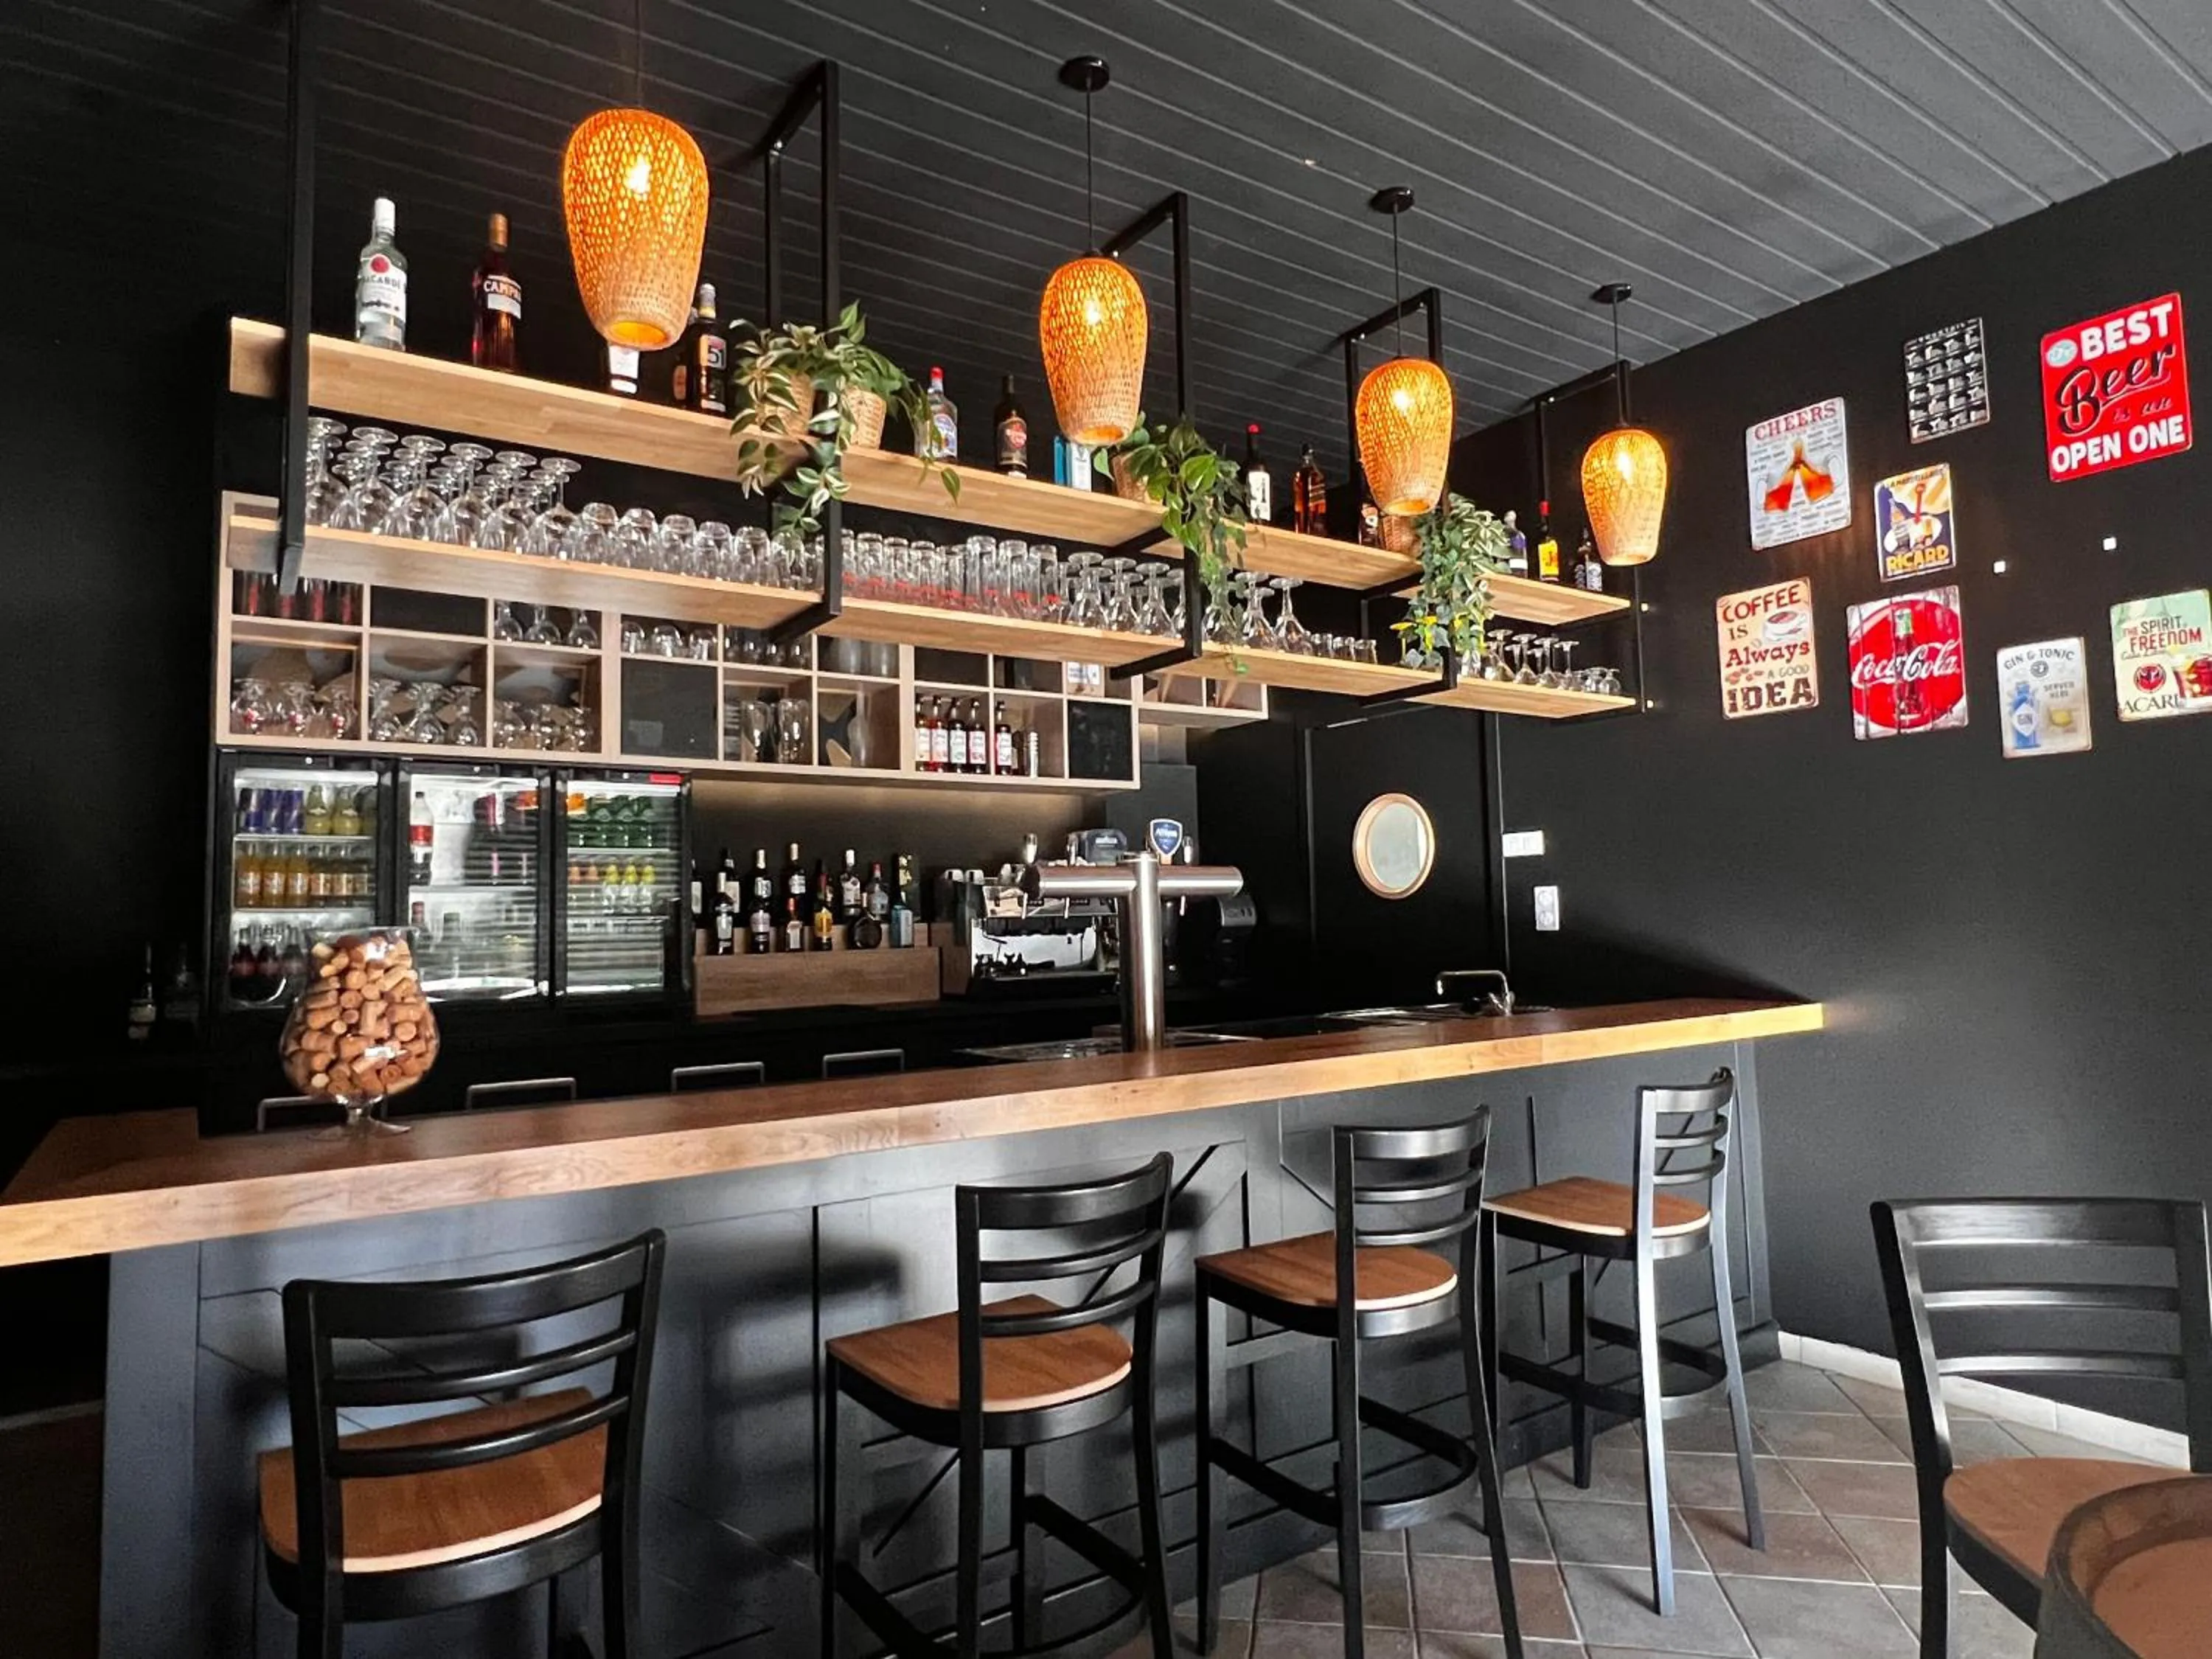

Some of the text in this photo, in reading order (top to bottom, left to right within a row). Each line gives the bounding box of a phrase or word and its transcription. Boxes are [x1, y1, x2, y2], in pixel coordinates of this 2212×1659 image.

[2080, 302, 2173, 361] BEST
[2056, 343, 2177, 437] Beer
[1754, 401, 1837, 440] CHEERS
[2051, 431, 2121, 473] OPEN
[2128, 414, 2185, 453] ONE
[1886, 544, 1949, 573] RICARD
[1722, 584, 1801, 623] COFFEE
[1728, 625, 1748, 641] IS
[2129, 627, 2202, 653] FREEDOM
[2140, 615, 2182, 635] SPIRIT
[1725, 641, 1810, 668] Always
[1851, 639, 1961, 689] Coca-Cola
[2003, 653, 2024, 670] GIN
[2039, 648, 2075, 661] TONIC
[1779, 664, 1810, 678] GOOD
[1727, 677, 1814, 713] IDEA
